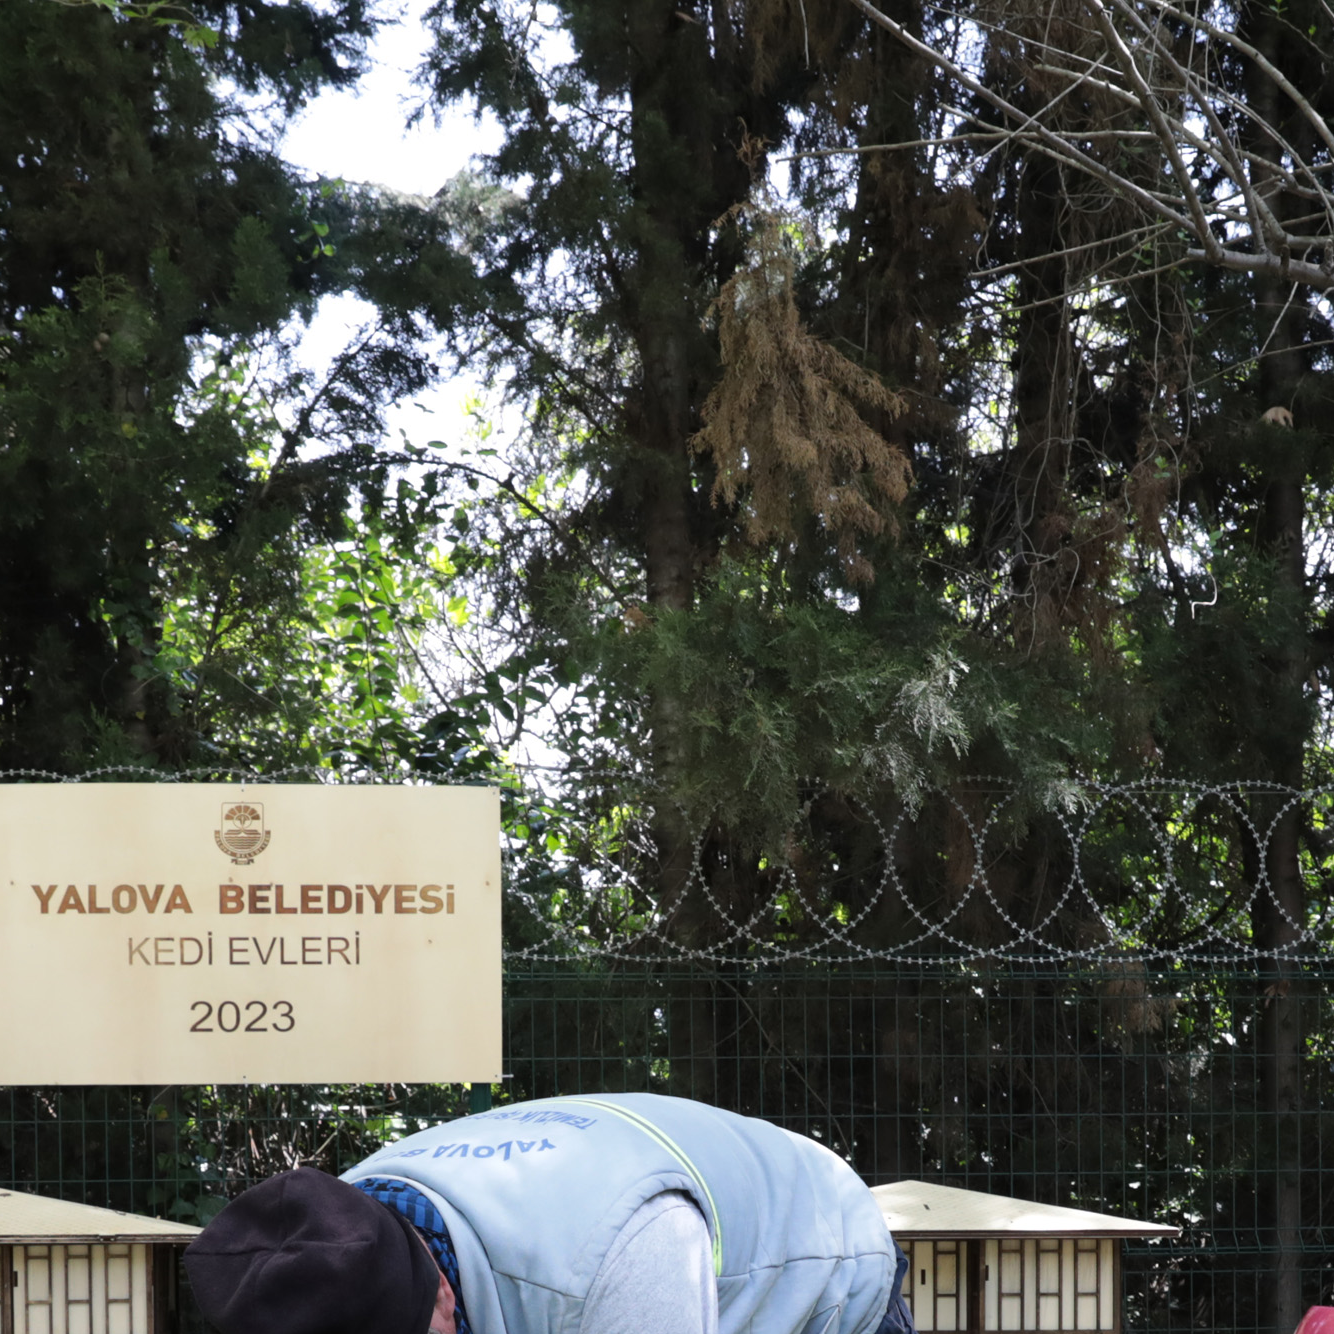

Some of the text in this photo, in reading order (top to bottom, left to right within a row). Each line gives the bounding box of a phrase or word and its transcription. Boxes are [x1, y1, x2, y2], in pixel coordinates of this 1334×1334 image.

[31, 884, 455, 914] YALOVA BELEDİYESİ
[127, 931, 361, 965] KEDİ EVLERİ
[189, 1000, 296, 1032] 2023
[432, 1138, 556, 1161] YALOVA
